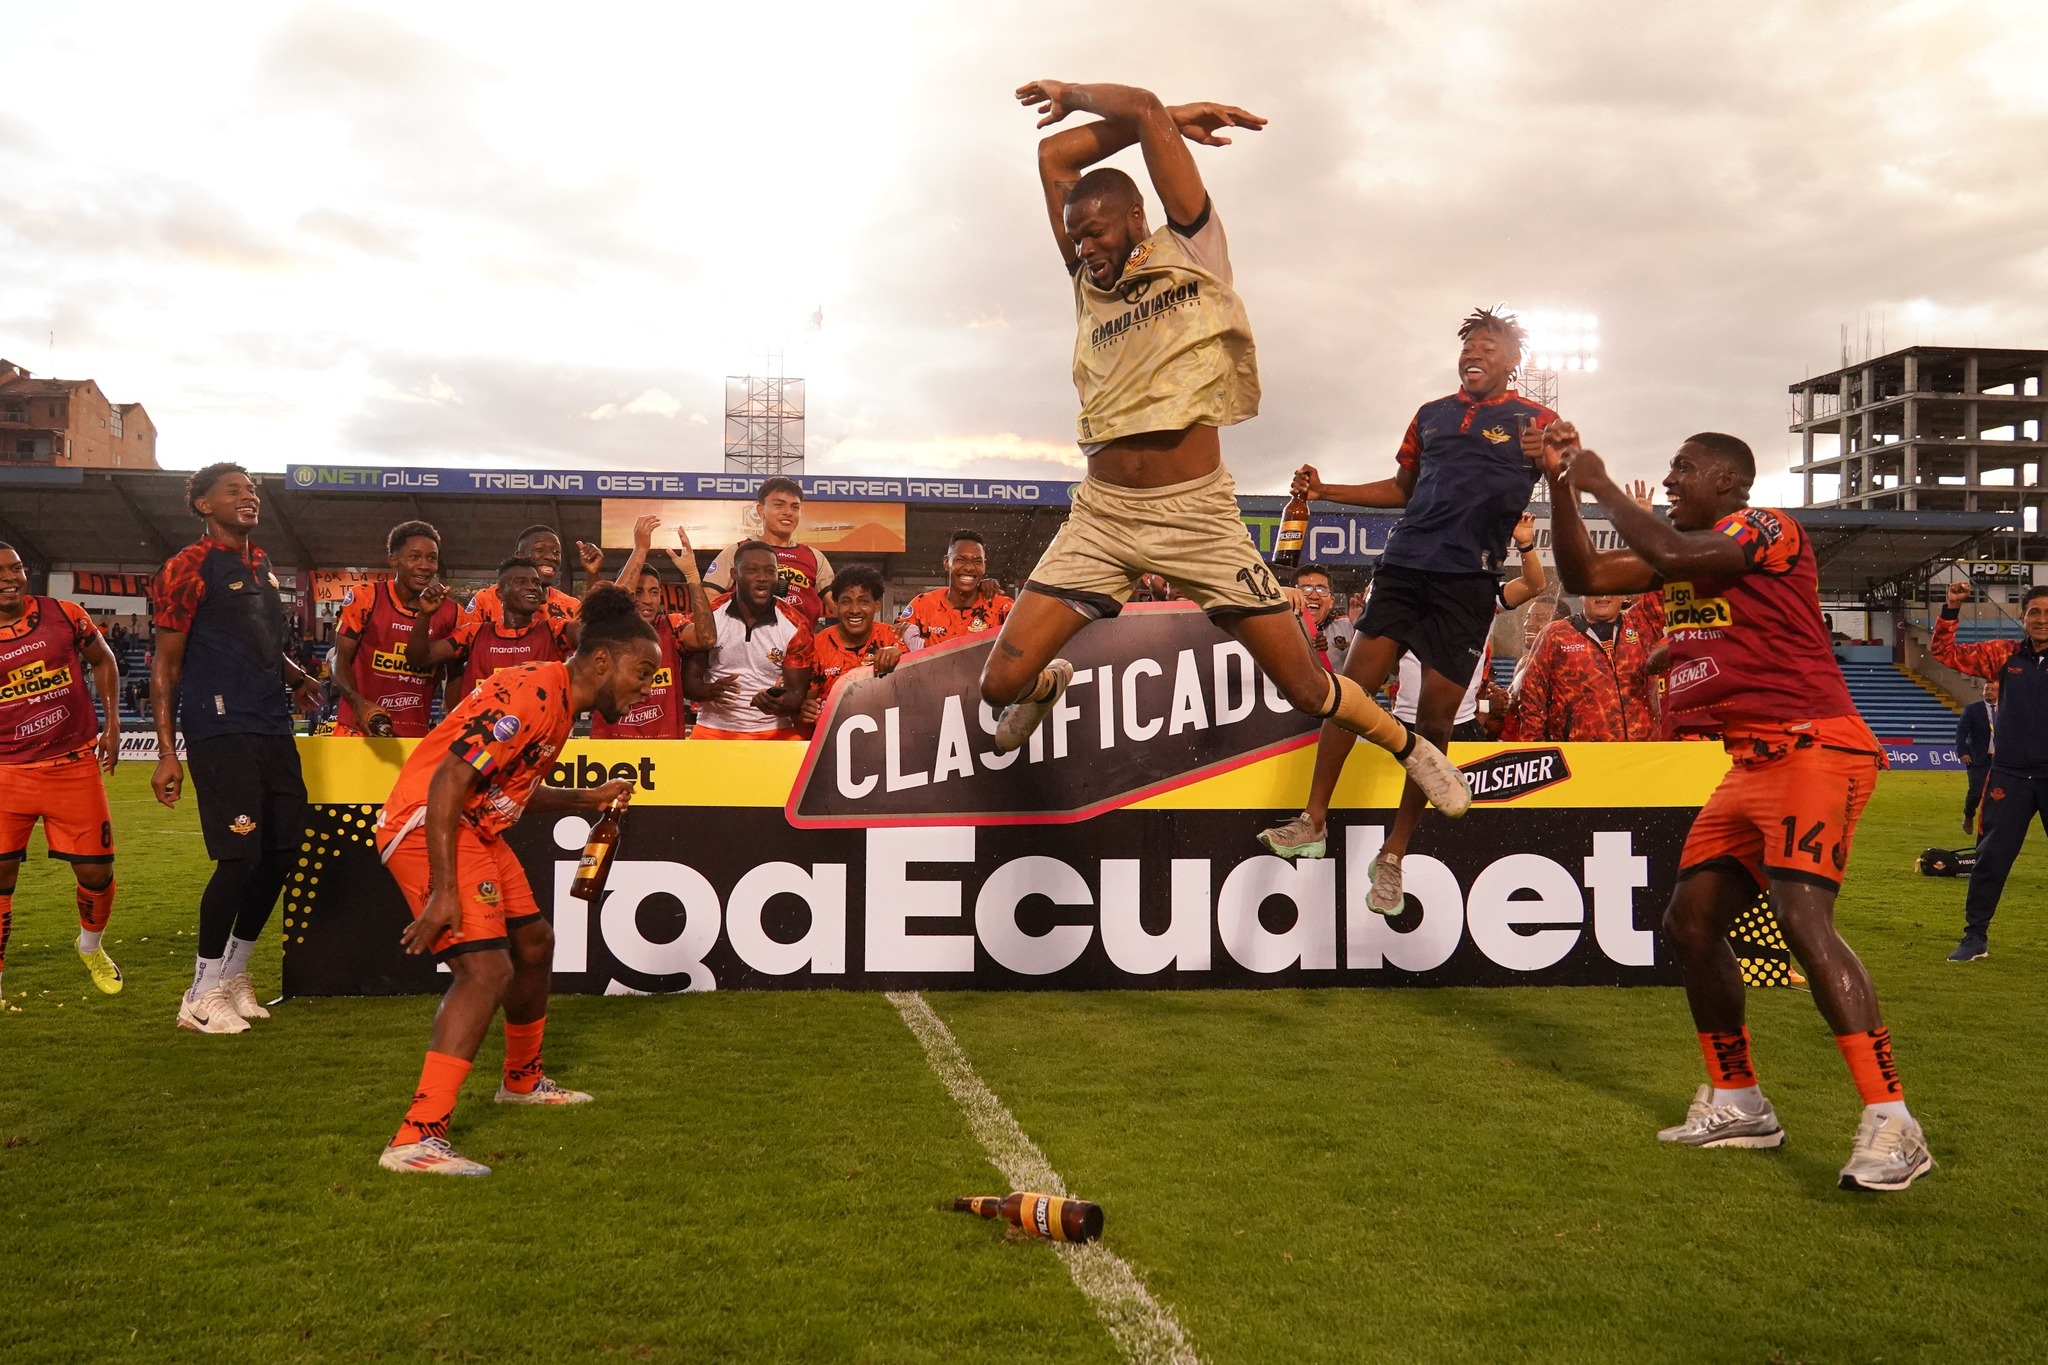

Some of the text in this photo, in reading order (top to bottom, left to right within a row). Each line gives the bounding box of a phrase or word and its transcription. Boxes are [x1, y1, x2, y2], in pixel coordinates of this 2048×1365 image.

[469, 473, 583, 490] TRIBUNA
[597, 475, 684, 492] OESTE:
[697, 477, 765, 494] PEDR
[803, 480, 903, 496] LARREA
[907, 482, 1040, 500] ARELLANO
[1236, 563, 1281, 602] 12
[0, 668, 70, 700] cuabet
[43, 686, 71, 702] xtrim
[649, 687, 667, 697] trim
[381, 696, 420, 707] PILSENER
[20, 709, 63, 737] PILSENER
[1886, 750, 1919, 763] clipp
[1463, 755, 1554, 795] PILSENER
[1781, 815, 1826, 864] 14
[437, 815, 1654, 996] igaEcuabet
